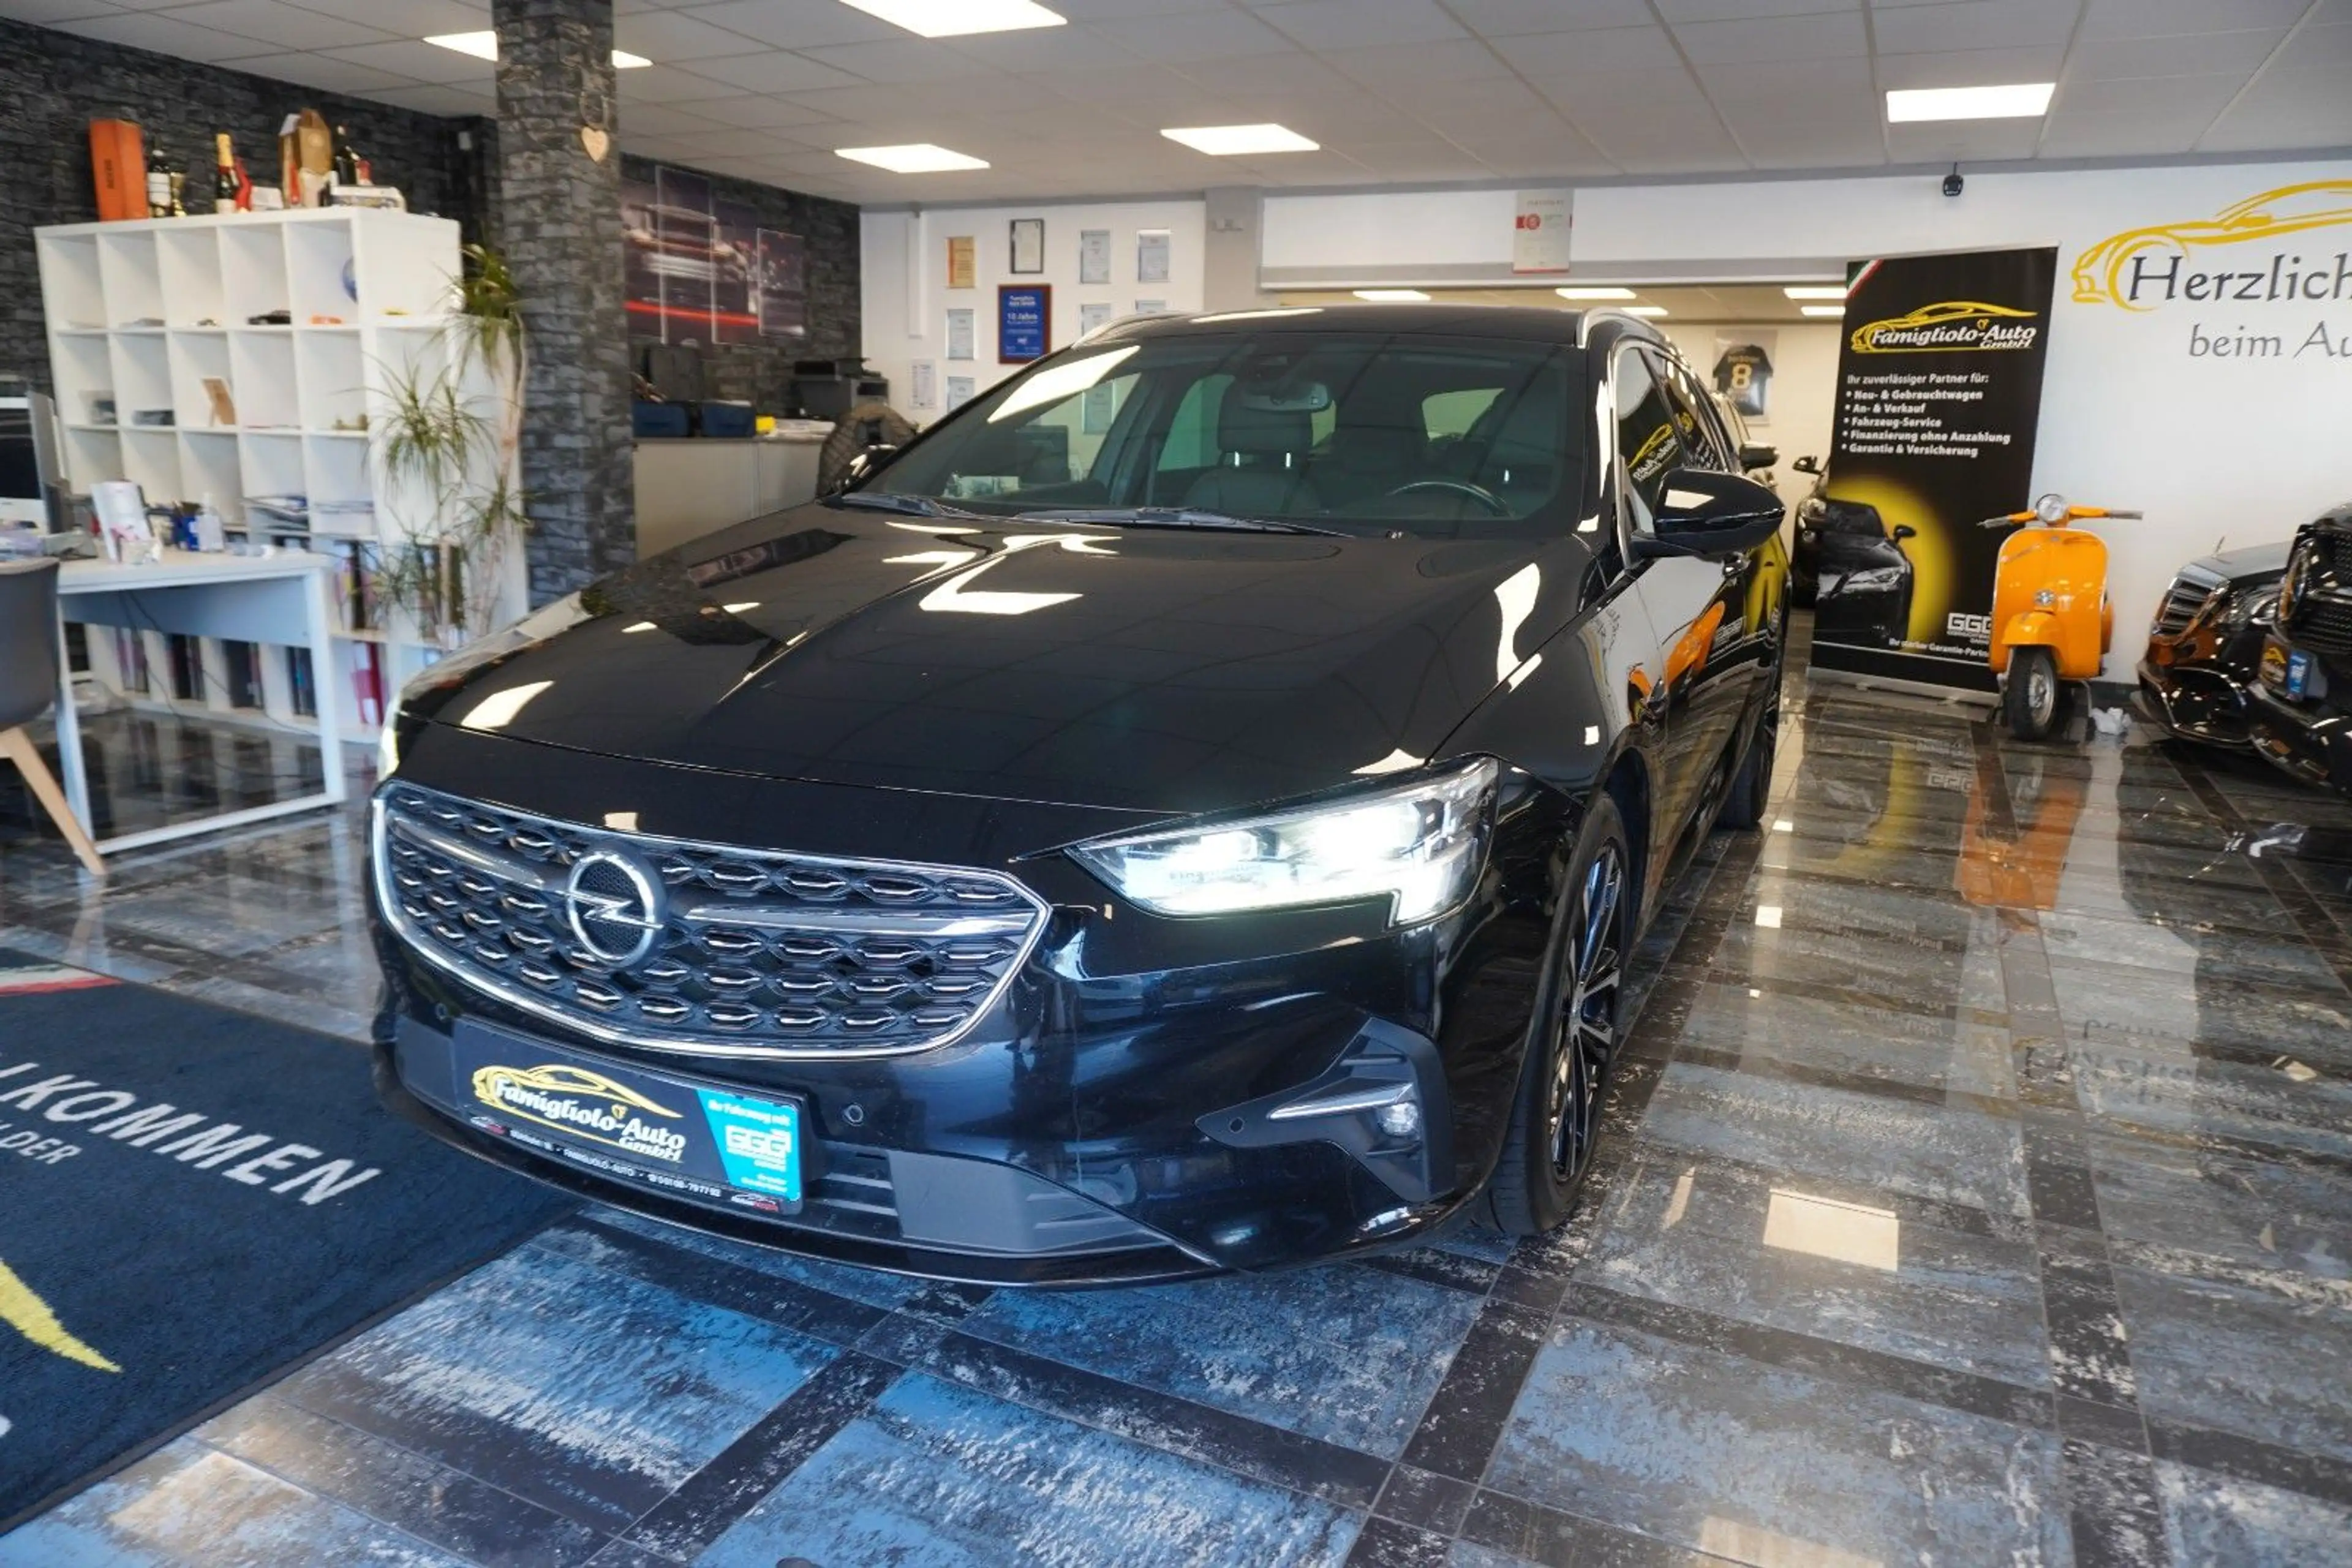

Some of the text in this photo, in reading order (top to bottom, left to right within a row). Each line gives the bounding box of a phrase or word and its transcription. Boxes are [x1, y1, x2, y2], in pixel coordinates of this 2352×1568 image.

[2128, 252, 2352, 301] Herzlich
[1979, 339, 2033, 350] GmbH
[2188, 322, 2282, 358] beim
[1732, 363, 1752, 389] 8
[1847, 372, 1989, 386] Ihr zuverlässiger Partner für:
[1854, 390, 1984, 402] Neu- & Gebrauchtwagen
[1852, 403, 1927, 413] An- & Verkauf
[1852, 417, 1942, 429] Fahrzeug-Service
[1850, 431, 2011, 445] Finanzierung ohne Anzahlung
[1849, 443, 1978, 458] Garantie & Versicherung
[0, 1120, 83, 1164] DER
[619, 1136, 684, 1162] GmbH
